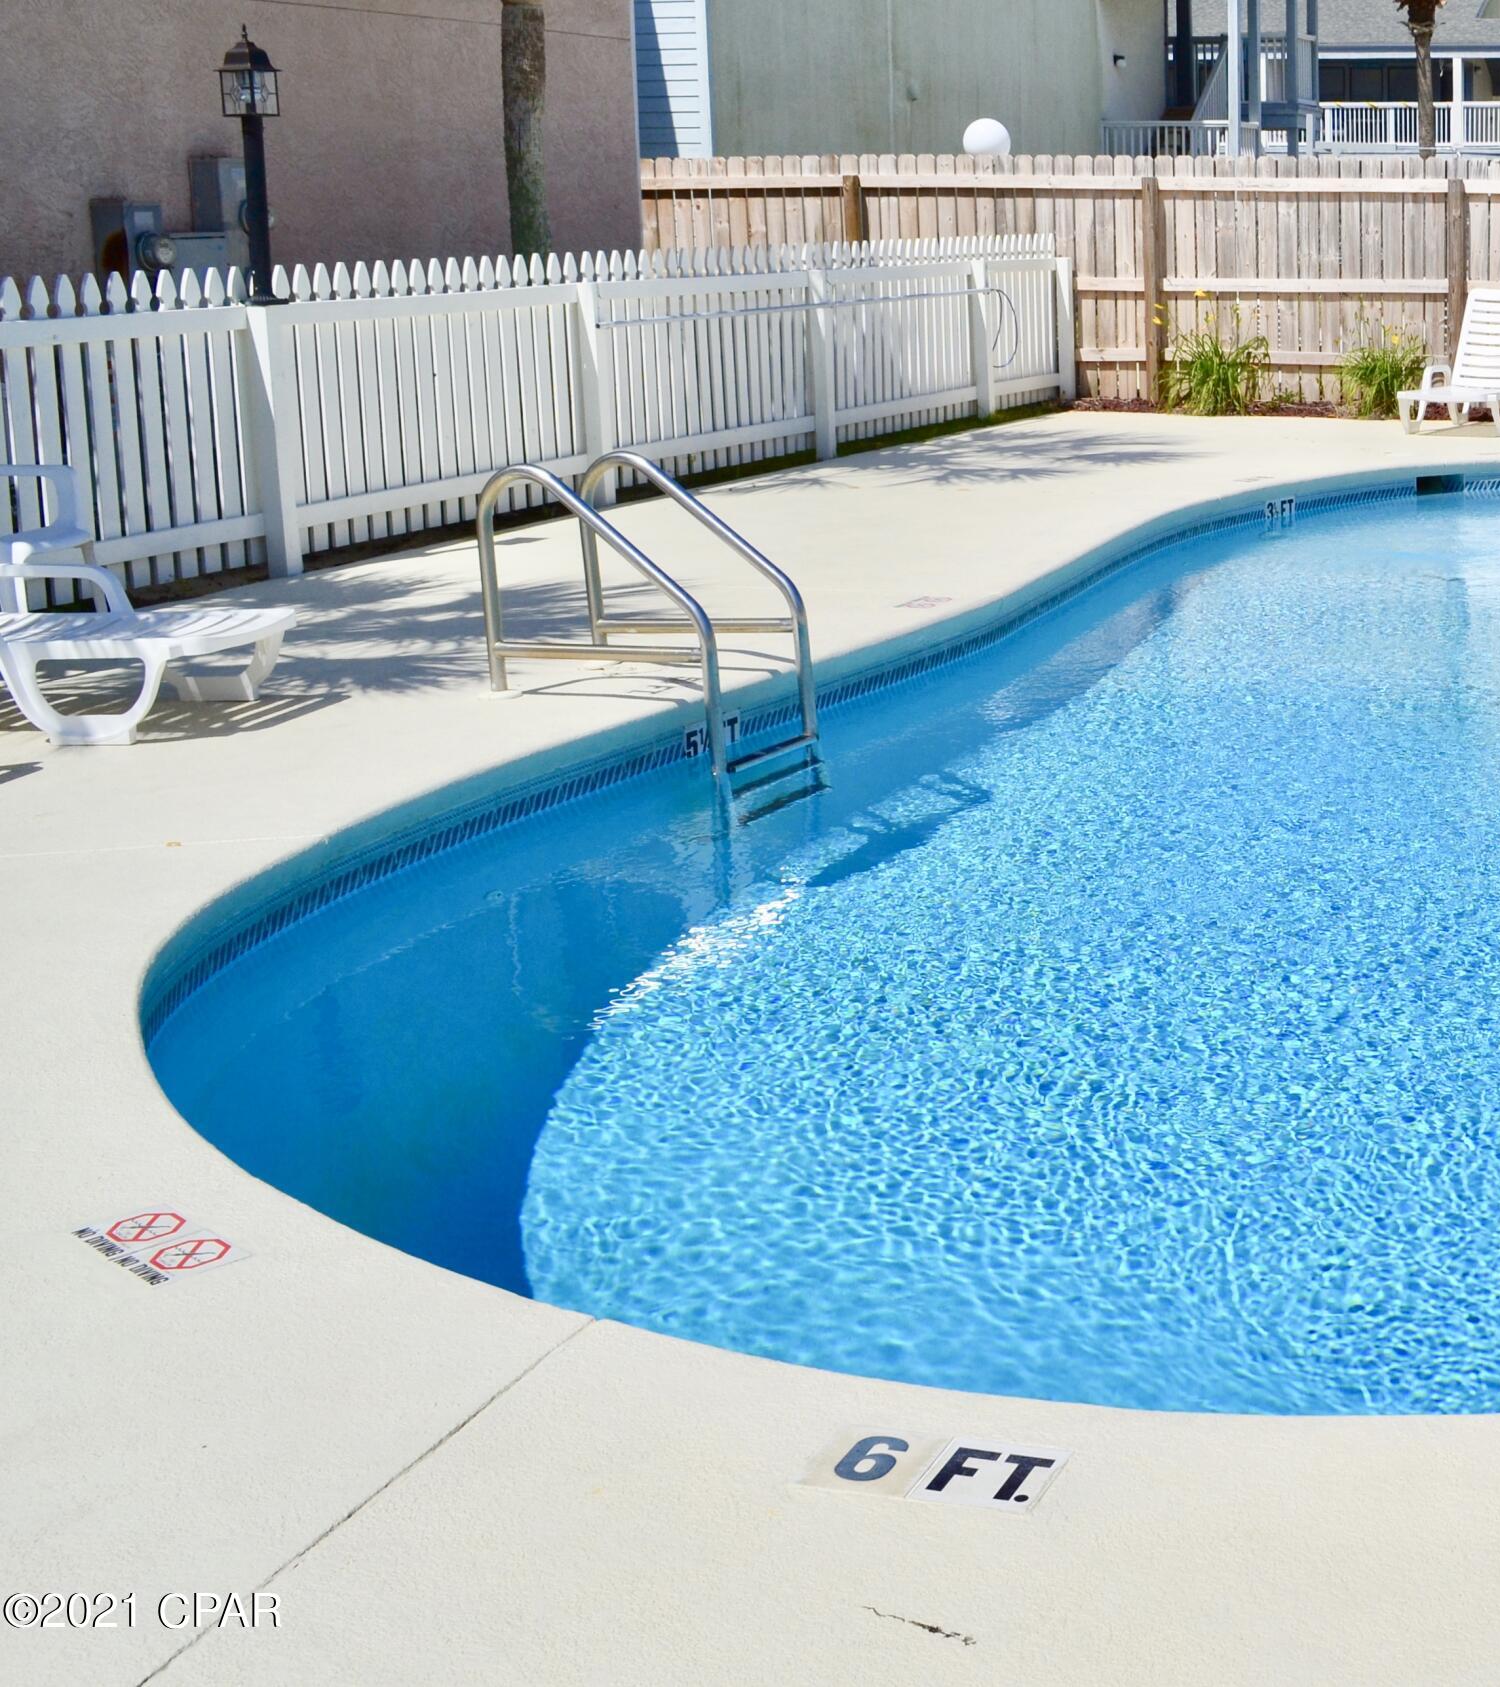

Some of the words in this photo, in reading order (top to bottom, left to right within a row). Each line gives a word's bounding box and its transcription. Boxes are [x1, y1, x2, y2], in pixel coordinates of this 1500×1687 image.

[72, 1226, 97, 1239] NO
[84, 1235, 124, 1258] DIVING
[115, 1255, 140, 1268] NO
[128, 1263, 169, 1286] DIVING
[834, 1435, 909, 1482] 6
